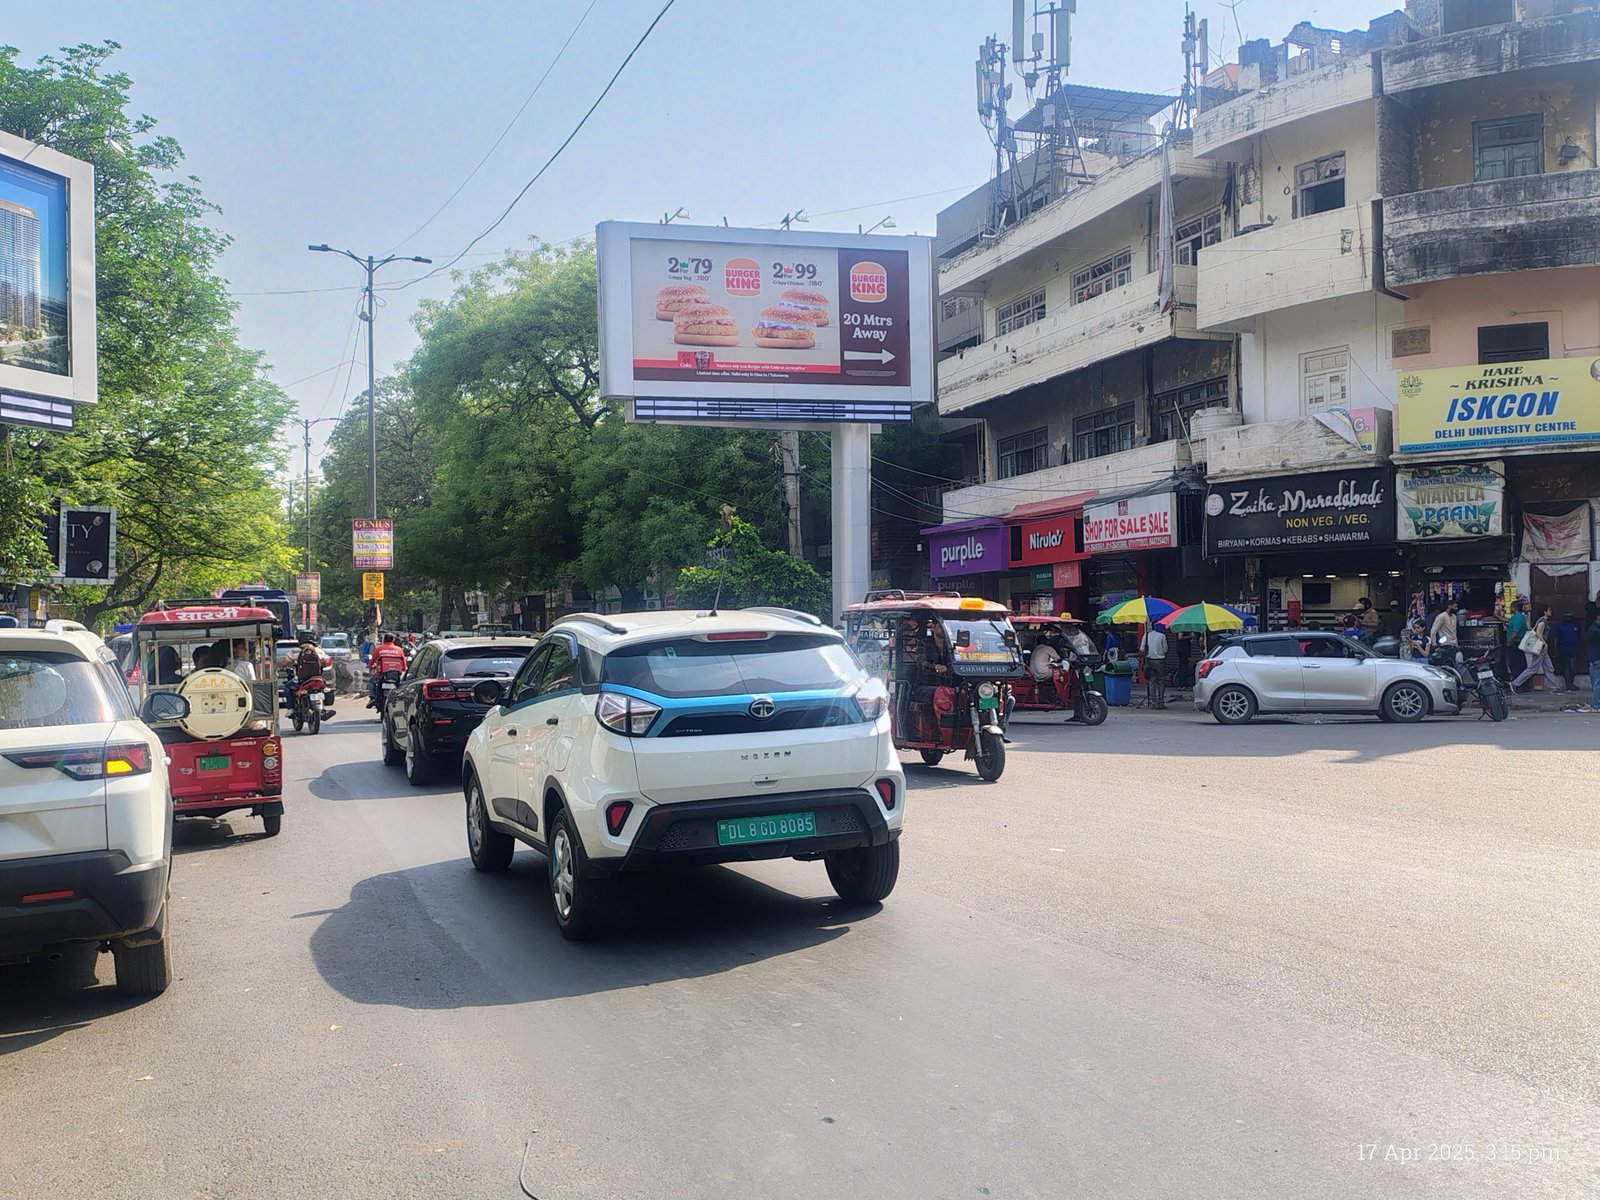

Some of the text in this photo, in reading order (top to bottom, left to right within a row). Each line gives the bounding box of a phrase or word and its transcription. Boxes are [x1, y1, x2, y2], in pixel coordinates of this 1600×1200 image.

[668, 257, 679, 273] 2
[772, 262, 783, 279] 2
[725, 269, 760, 279] BURGER
[851, 274, 885, 284] BURGER
[725, 278, 760, 290] KING
[851, 282, 885, 295] KING
[843, 313, 893, 327] 20 Mtrs
[852, 327, 887, 342] Away
[1482, 366, 1524, 377] HARE
[1465, 375, 1544, 390] KRISHNA
[1446, 391, 1560, 423] ISKCON
[1434, 421, 1577, 440] DELHI UNIVERSITY CENTRE
[1229, 487, 1277, 517] Zaika
[1277, 479, 1385, 518] Muradabadi
[1416, 486, 1485, 505] MANGLA
[1286, 518, 1309, 529] NON
[1311, 517, 1336, 528] VEG.
[1344, 513, 1371, 525] VEG.
[1424, 504, 1477, 522] PAAN
[354, 520, 391, 530] GENIUS
[1084, 511, 1169, 542] SHOP FOR SALE SALE
[1029, 528, 1064, 550] Nirula's
[1217, 531, 1370, 549] BIRYANI KORMAS KEBABS SHAWARMA
[941, 536, 984, 568] purplle
[175, 607, 238, 621] सारथी
[961, 665, 1012, 673] SHAHENSHA
[728, 816, 814, 841] DL 8 GD 8085
